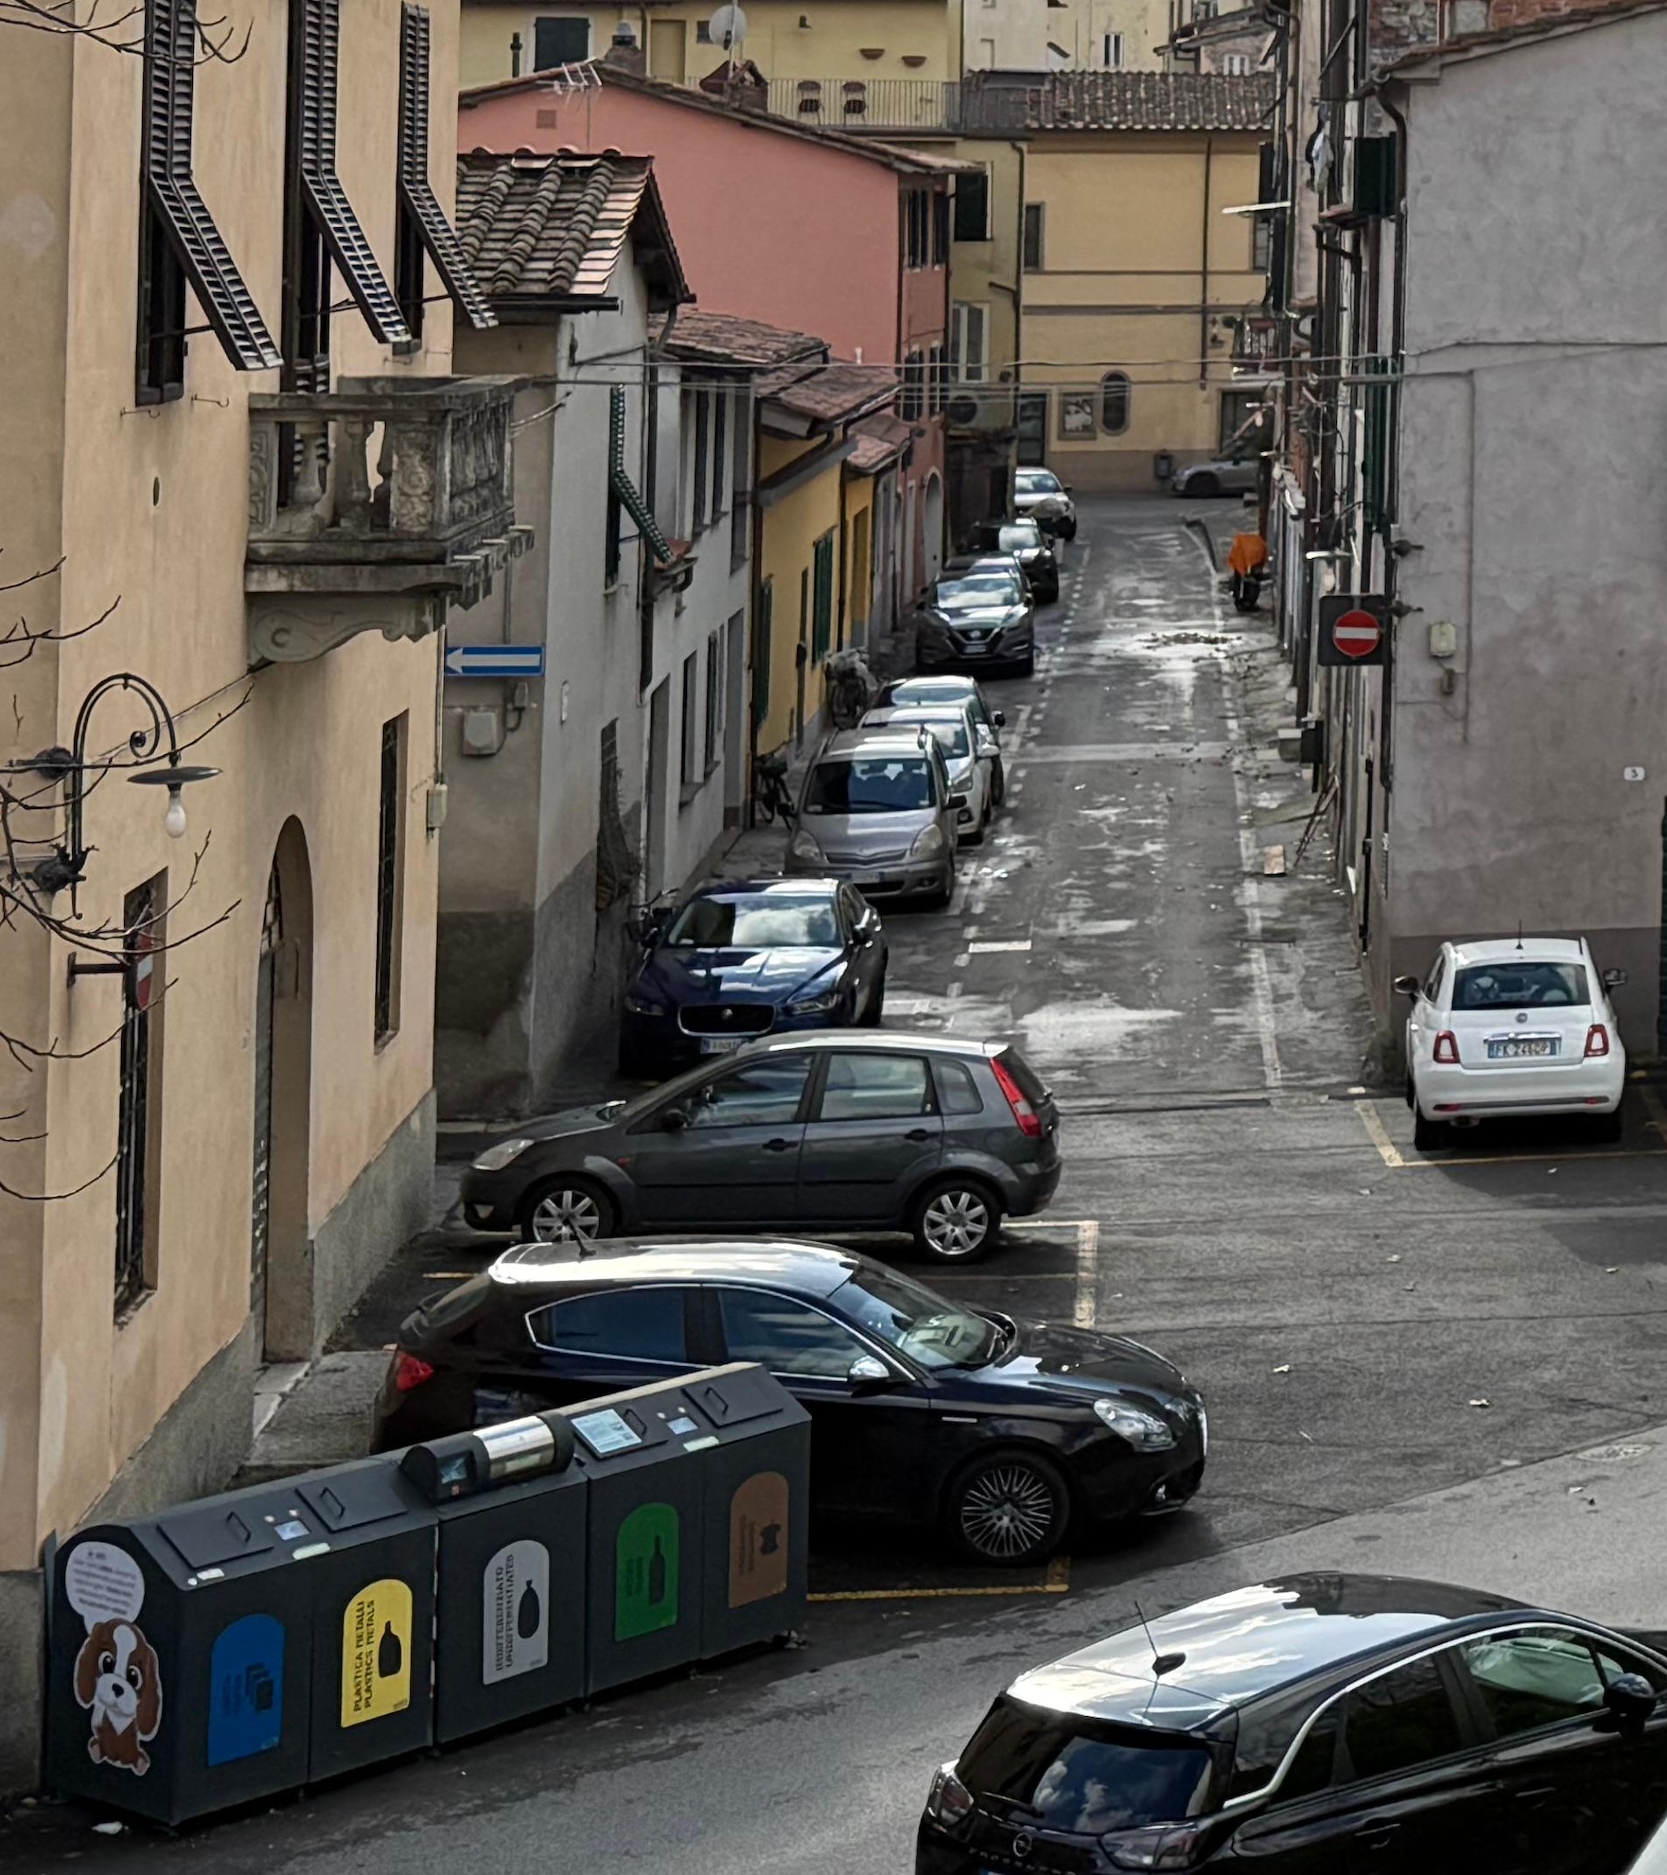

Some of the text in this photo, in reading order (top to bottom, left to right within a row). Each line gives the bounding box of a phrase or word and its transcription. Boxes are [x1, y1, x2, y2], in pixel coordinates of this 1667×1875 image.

[354, 1601, 365, 1712] PLASTICA METALLI
[364, 1600, 375, 1709] PLASTICS METALS
